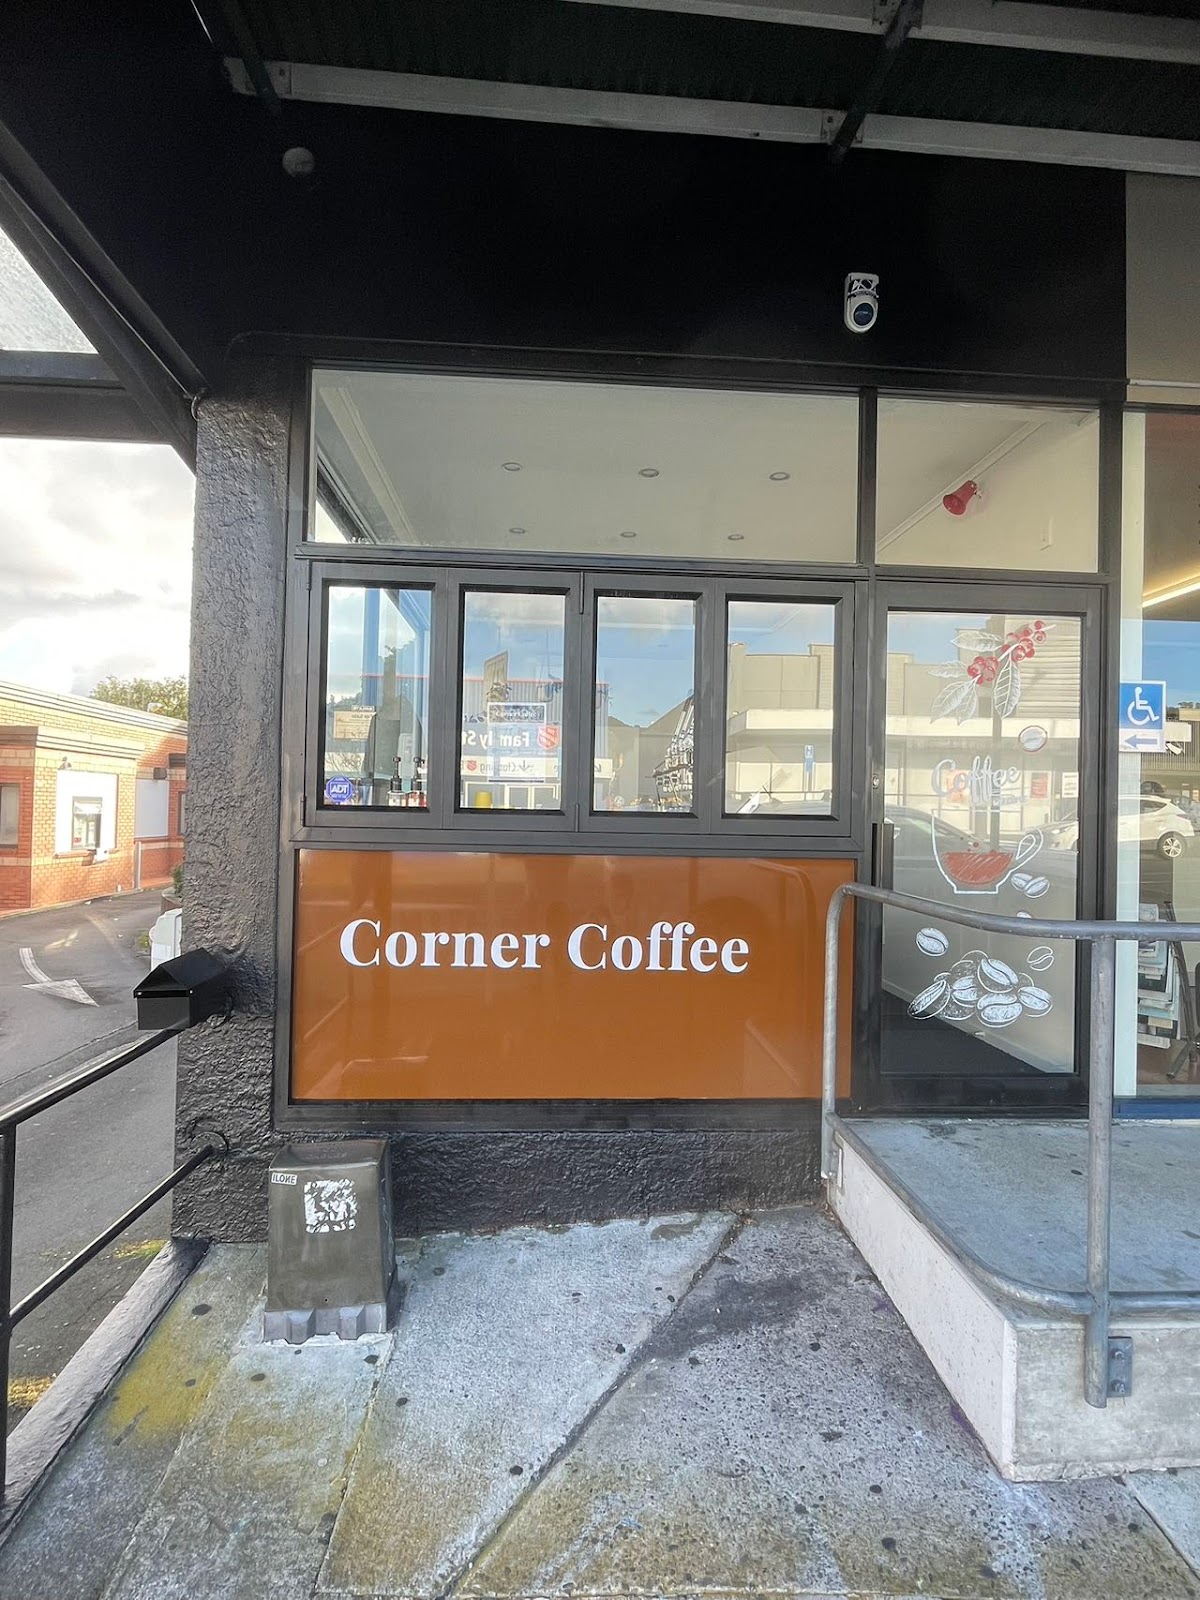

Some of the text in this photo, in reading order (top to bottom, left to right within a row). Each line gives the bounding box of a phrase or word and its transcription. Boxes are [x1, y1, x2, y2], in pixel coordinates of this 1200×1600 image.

[331, 784, 348, 793] ADT
[931, 755, 1021, 804] Coffee
[339, 918, 750, 973] Corner Coffee
